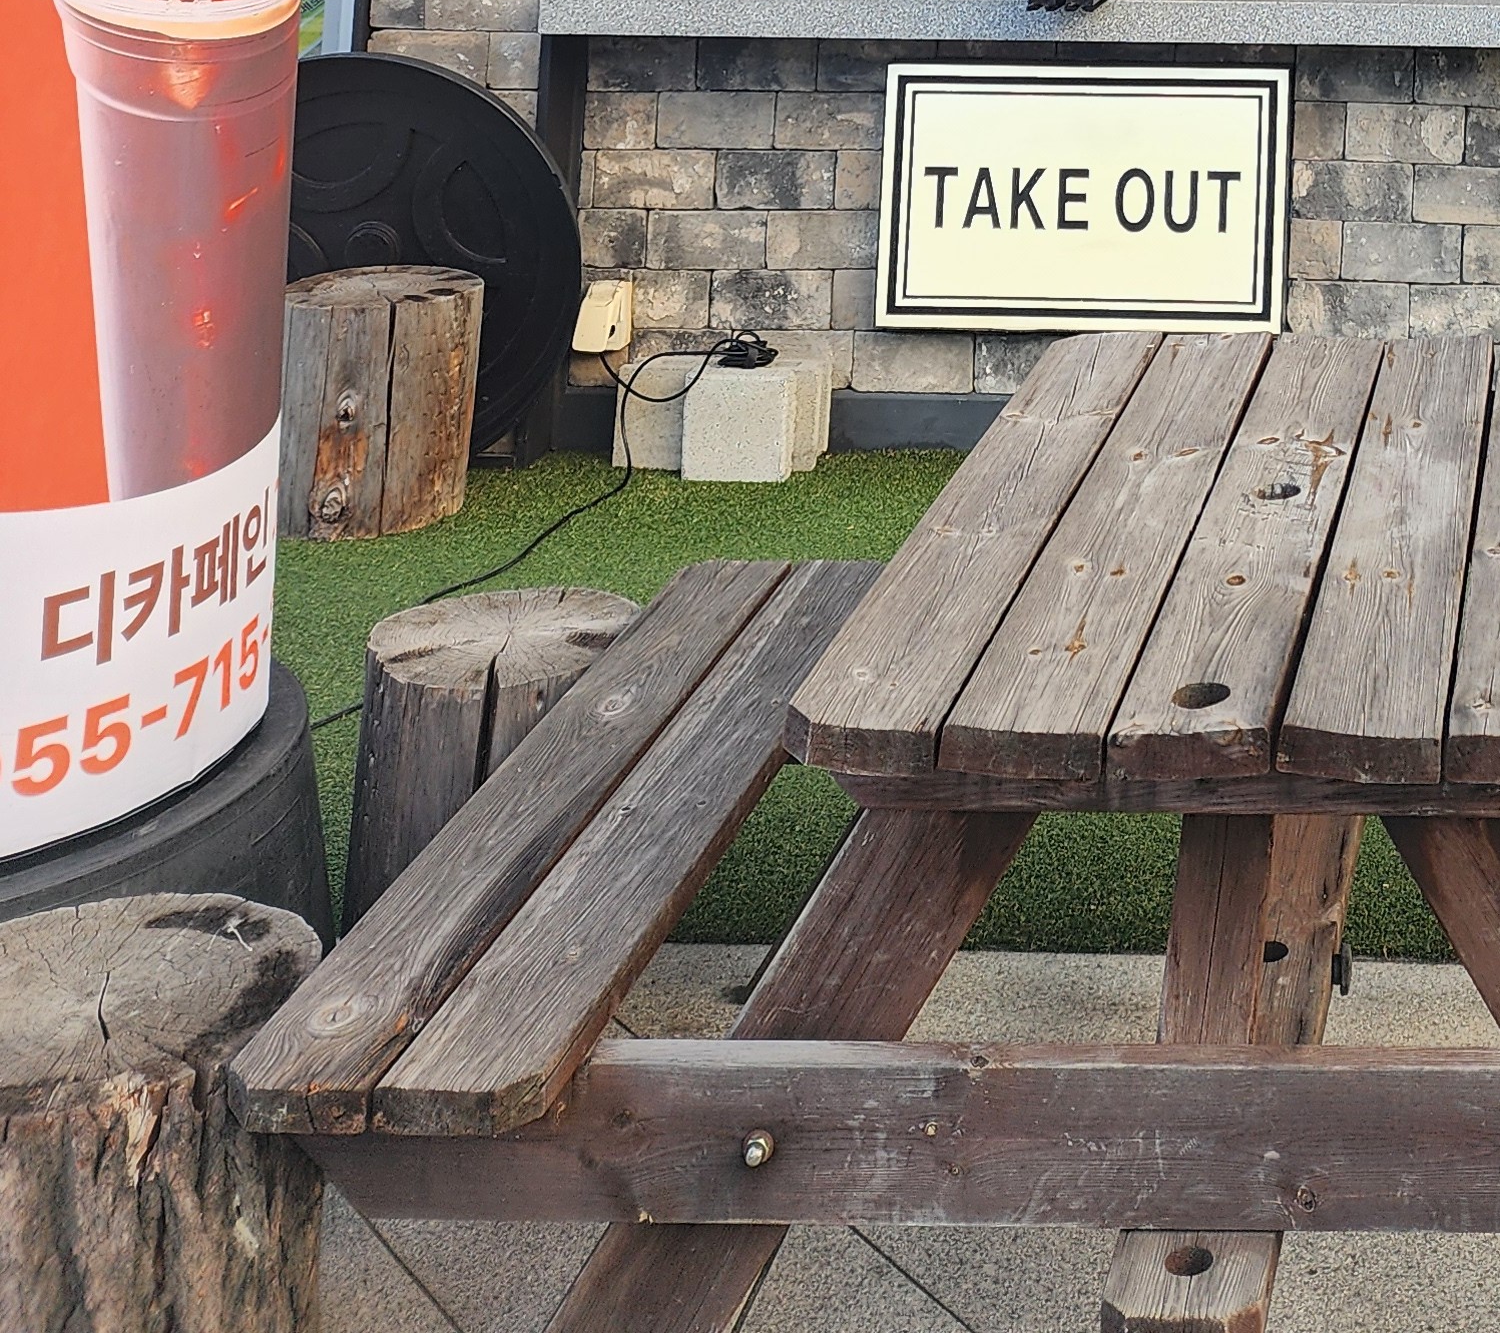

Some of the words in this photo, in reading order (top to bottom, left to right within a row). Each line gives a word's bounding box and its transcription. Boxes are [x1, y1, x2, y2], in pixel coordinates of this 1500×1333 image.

[924, 166, 1089, 231] TAKE
[1115, 168, 1241, 233] OUT
[41, 485, 270, 665] 디카페인
